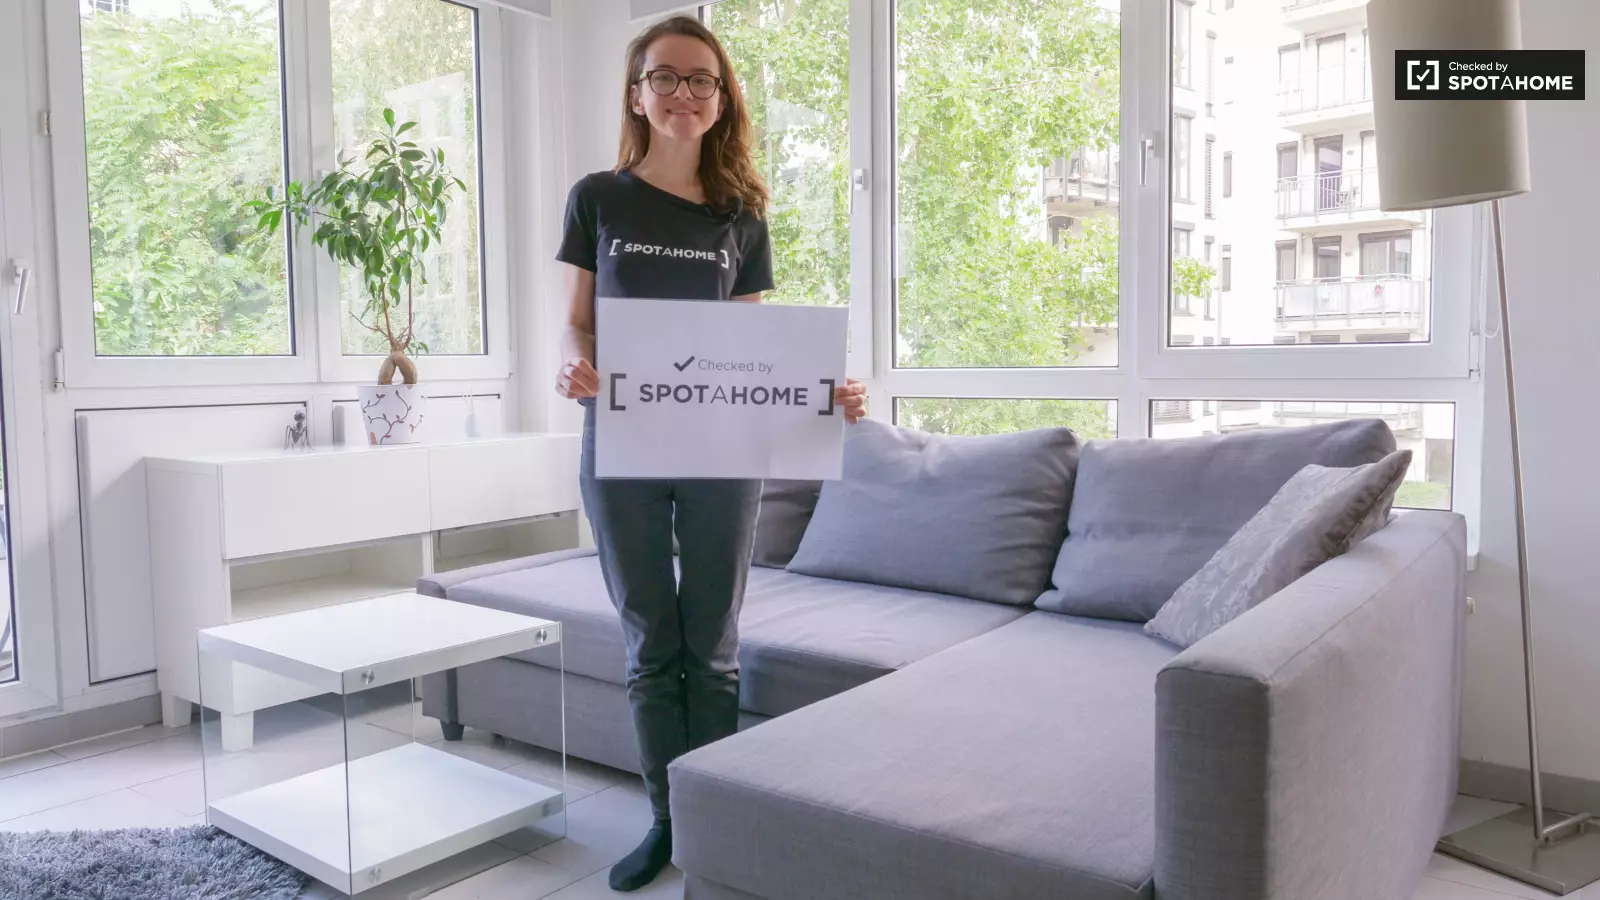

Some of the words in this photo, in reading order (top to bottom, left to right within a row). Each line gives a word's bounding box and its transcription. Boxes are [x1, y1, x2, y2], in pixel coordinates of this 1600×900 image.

[624, 243, 716, 261] SPOTAHOME
[698, 359, 754, 372] Checked
[758, 362, 774, 375] by
[639, 383, 808, 406] SPOTAHOME
